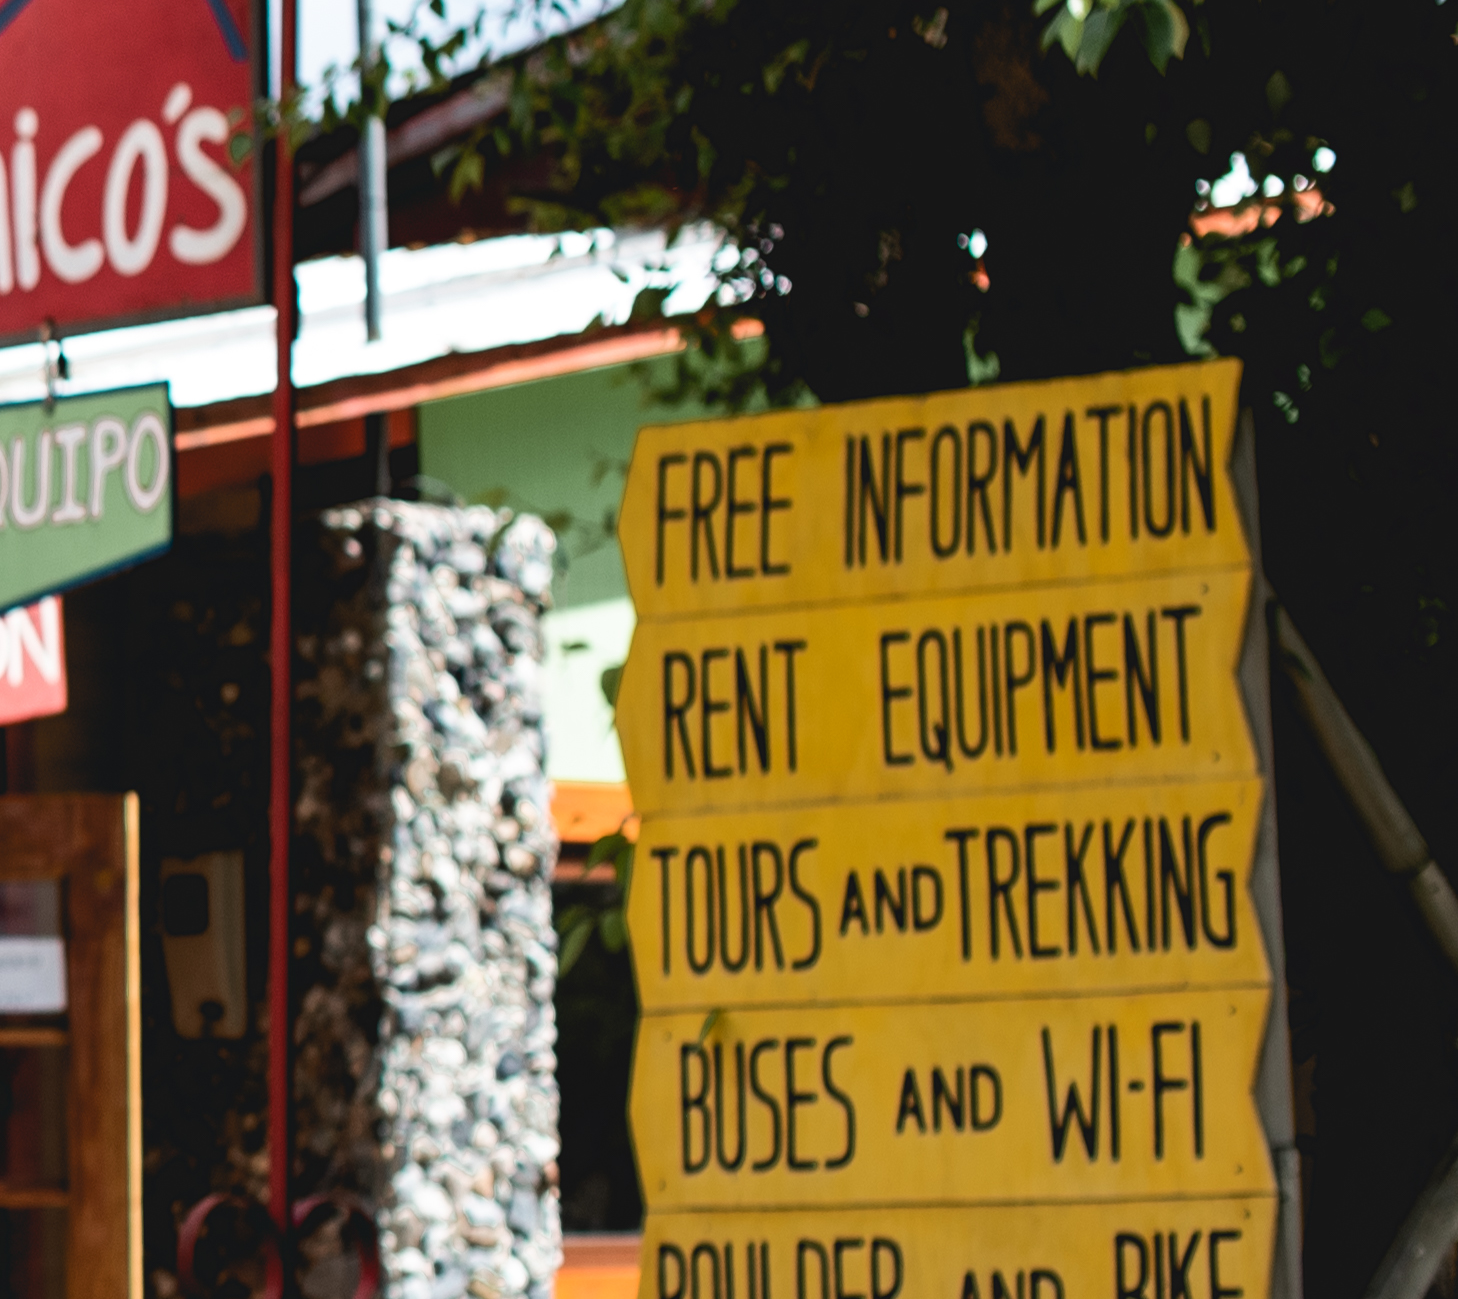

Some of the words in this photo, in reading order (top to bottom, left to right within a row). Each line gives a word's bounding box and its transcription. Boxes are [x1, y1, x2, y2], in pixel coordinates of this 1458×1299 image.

[654, 440, 794, 586] FREE
[844, 394, 1217, 572] INFORMATION
[662, 640, 808, 781] RENT
[879, 604, 1201, 773] EQUIPMENT
[650, 838, 823, 976] TOURS
[839, 864, 945, 936] AND
[945, 812, 1237, 962] TREKKING
[680, 1035, 856, 1174] BUSES
[895, 1063, 1004, 1135] AND
[1041, 1020, 1205, 1163] WI-FI
